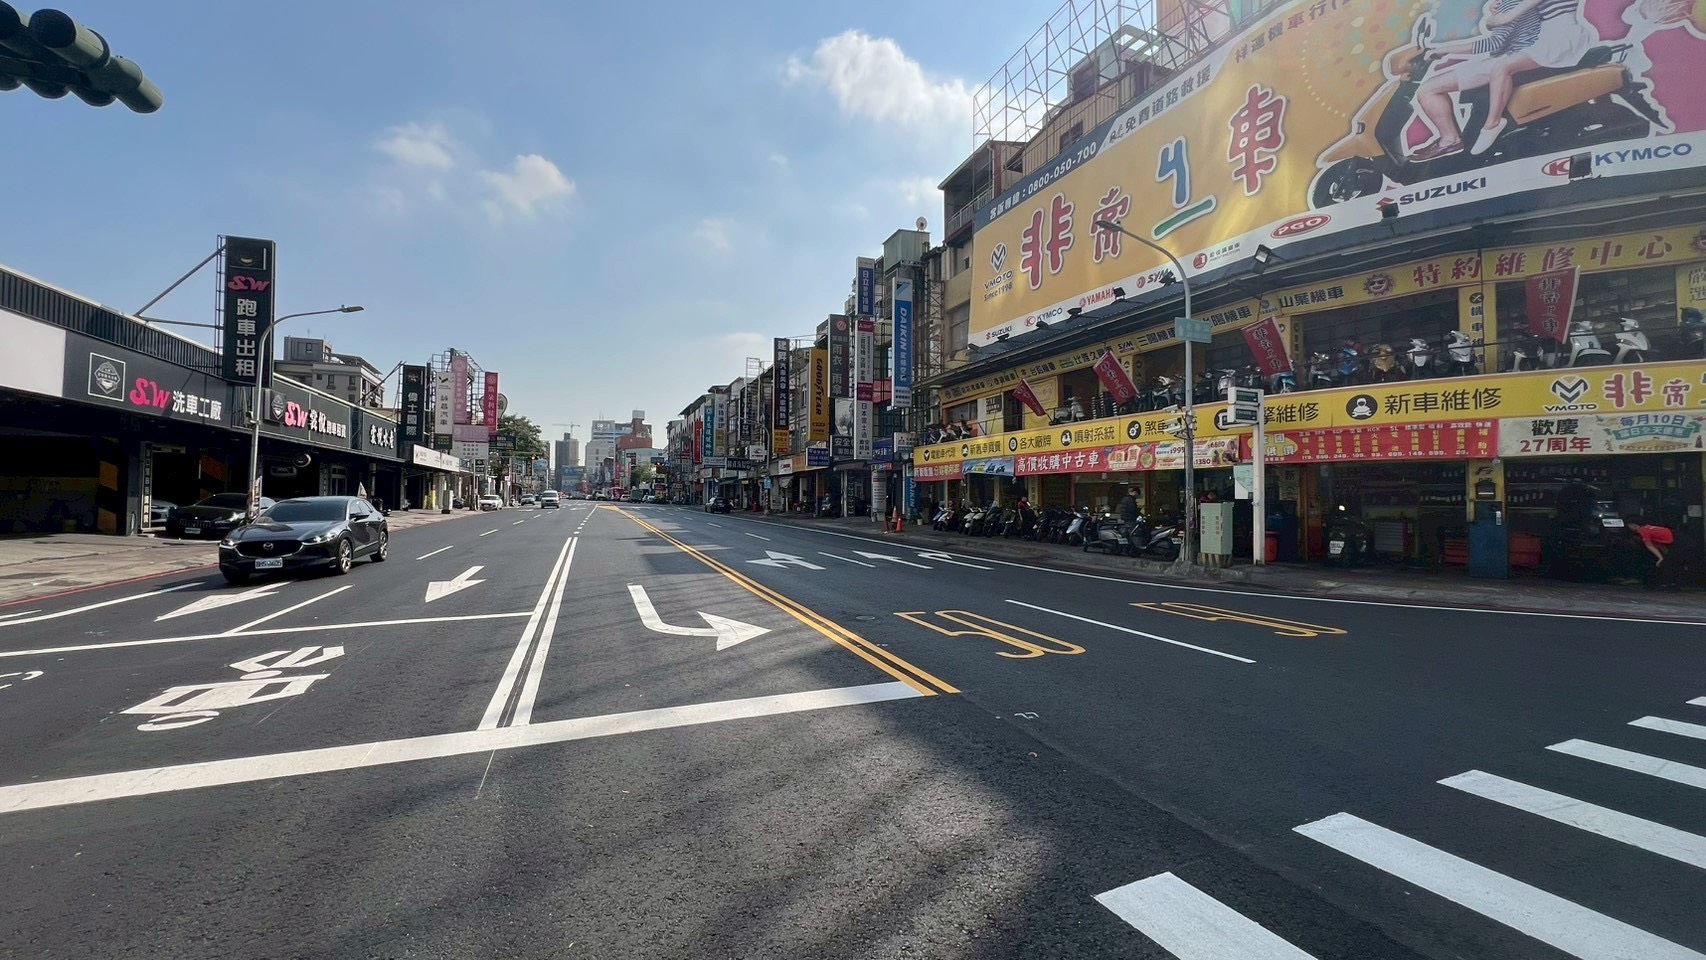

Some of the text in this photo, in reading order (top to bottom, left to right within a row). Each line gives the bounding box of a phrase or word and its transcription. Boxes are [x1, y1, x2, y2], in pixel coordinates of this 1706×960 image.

[1595, 142, 1692, 166] KYMCO
[1399, 176, 1487, 205] SUZUKI
[1278, 216, 1323, 237] PGO
[1413, 235, 1673, 287] 特約維修中心
[984, 270, 1013, 289] VMOTO
[1086, 287, 1115, 305] YAMAHA
[1280, 286, 1344, 308] 山葉機車
[1036, 307, 1063, 322] KYMCO
[235, 298, 257, 377] 跑車出租
[900, 307, 908, 350] DAIKIN
[991, 325, 1012, 338] SUZUKI
[1118, 340, 1135, 350] SYM
[815, 357, 825, 416] GOODYEAR
[1604, 371, 1706, 408] 非常
[172, 389, 222, 421] 洗車工廠
[1385, 387, 1501, 415] 新車維修
[1543, 403, 1597, 413] VMOTO
[1263, 402, 1319, 425] 擎維修
[1620, 414, 1686, 426] 每月10日
[1074, 426, 1115, 443] 噴射系統
[1531, 418, 1579, 437] 歡慶
[1019, 435, 1052, 450] 各大廠牌
[1519, 436, 1592, 453] 27周年
[1017, 450, 1099, 472] 高價收購中古車
[1129, 602, 1348, 637] 50
[893, 609, 1087, 659] 50
